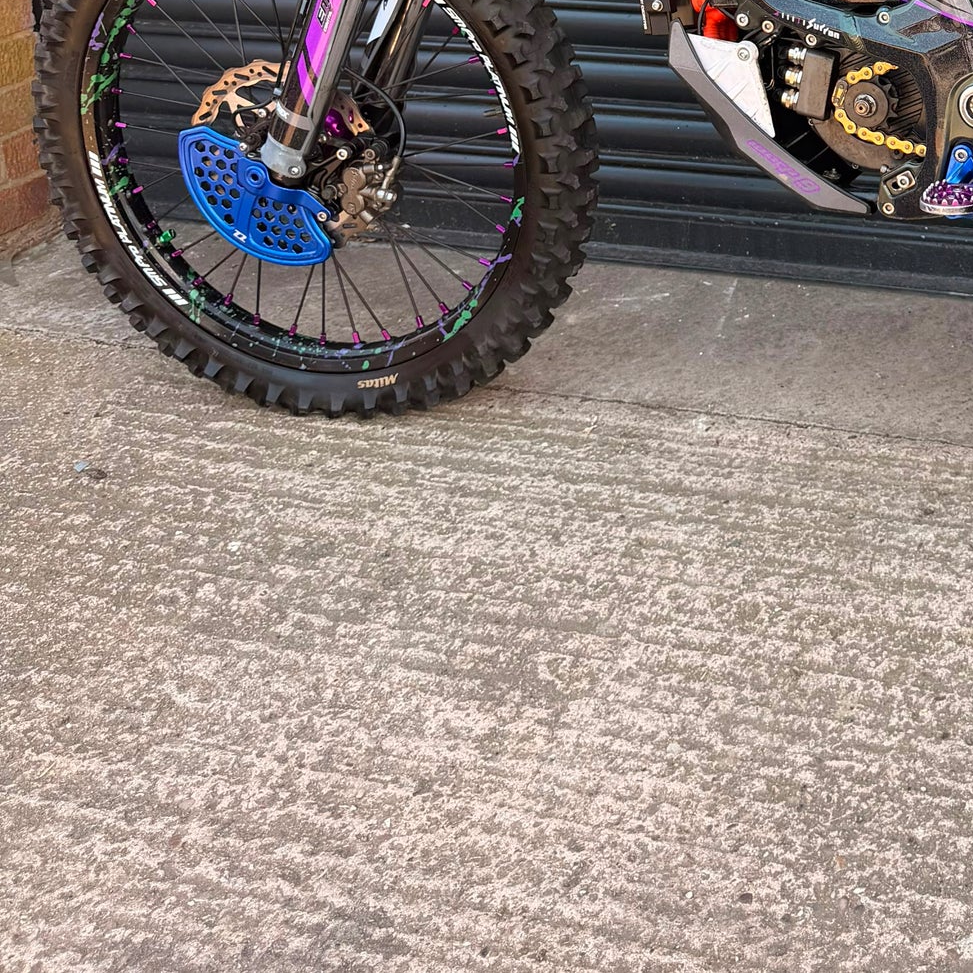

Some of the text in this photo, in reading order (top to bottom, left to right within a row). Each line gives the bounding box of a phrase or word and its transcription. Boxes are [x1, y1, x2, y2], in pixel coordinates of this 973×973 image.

[479, 53, 516, 126] PLATINUM
[94, 177, 133, 244] PLATINUM
[356, 372, 399, 389] Mitas
